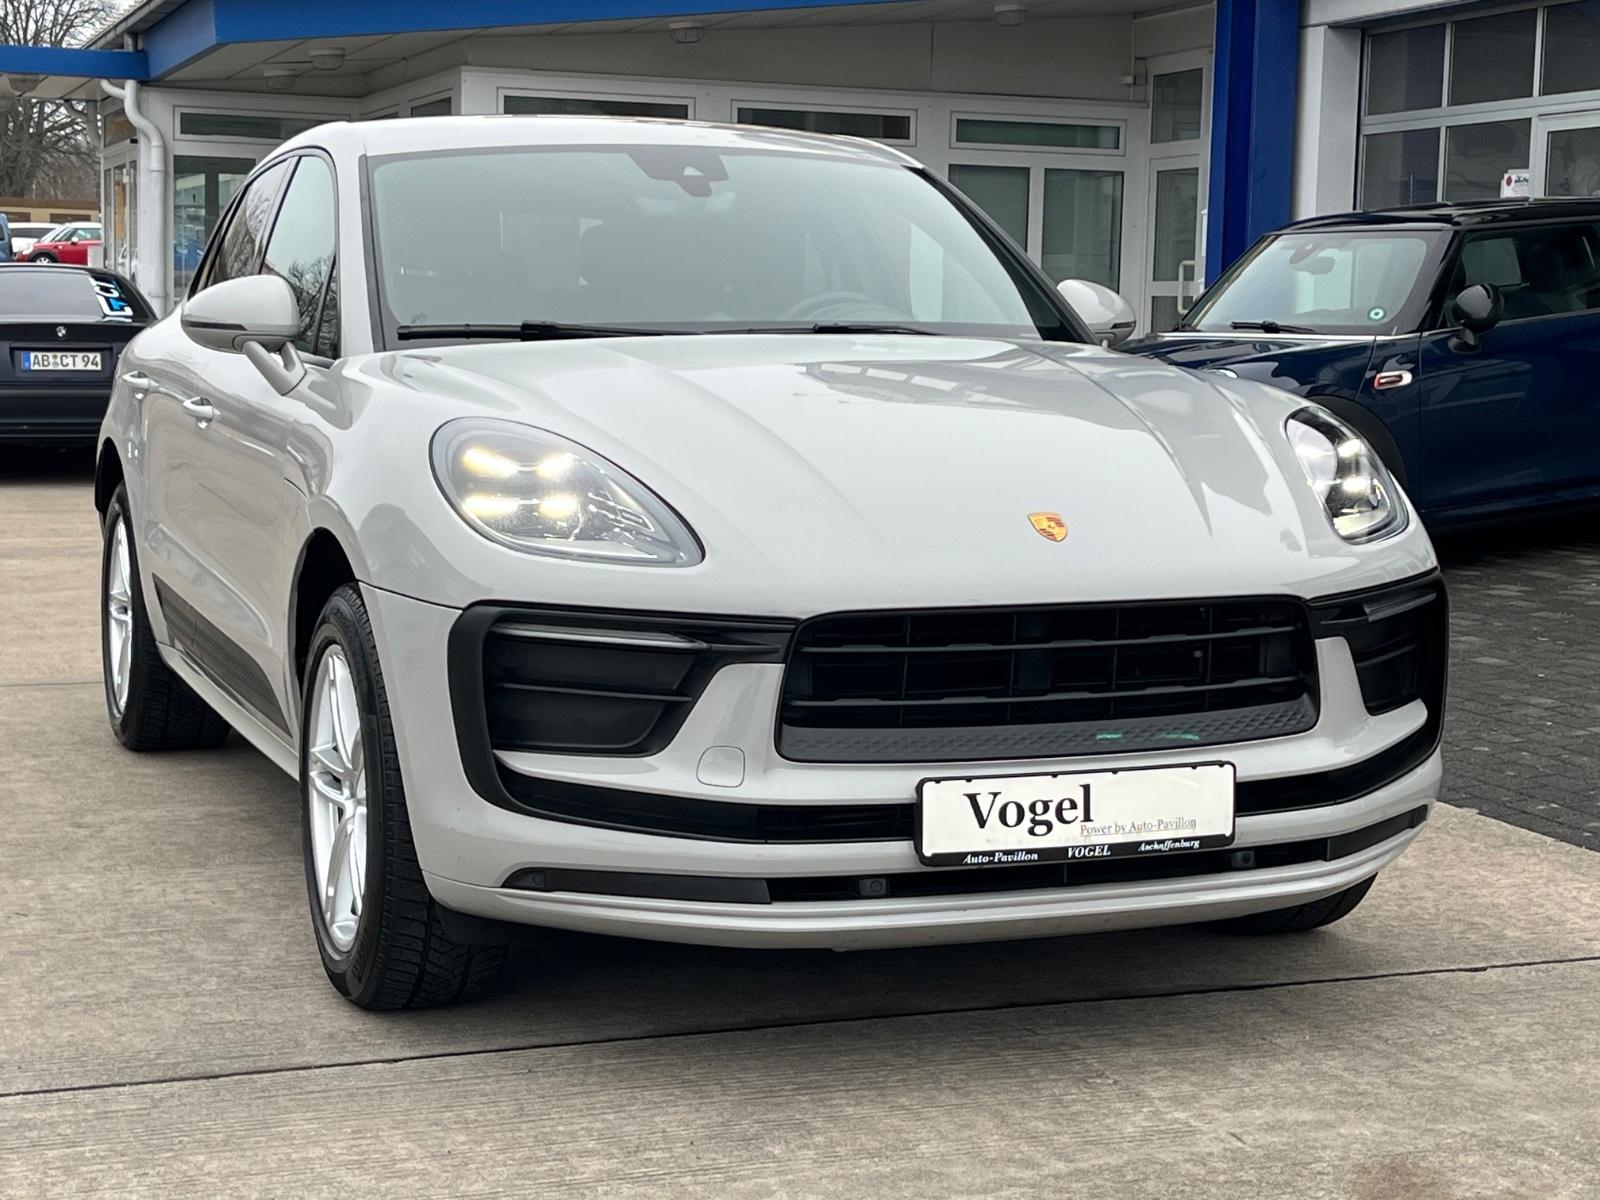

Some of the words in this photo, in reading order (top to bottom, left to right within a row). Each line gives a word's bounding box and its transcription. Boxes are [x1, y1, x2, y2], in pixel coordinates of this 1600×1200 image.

[32, 354, 50, 368] AB
[59, 354, 78, 368] CT
[81, 354, 99, 368] 94
[963, 783, 1094, 837] Vogel
[1080, 824, 1112, 836] Power
[1114, 821, 1127, 834] by
[1128, 817, 1197, 833] Auto-Pavillon
[962, 851, 1038, 864] Auto-Pavillon
[1067, 844, 1112, 858] VOGEL
[1138, 839, 1200, 851] Aschaffenburg
